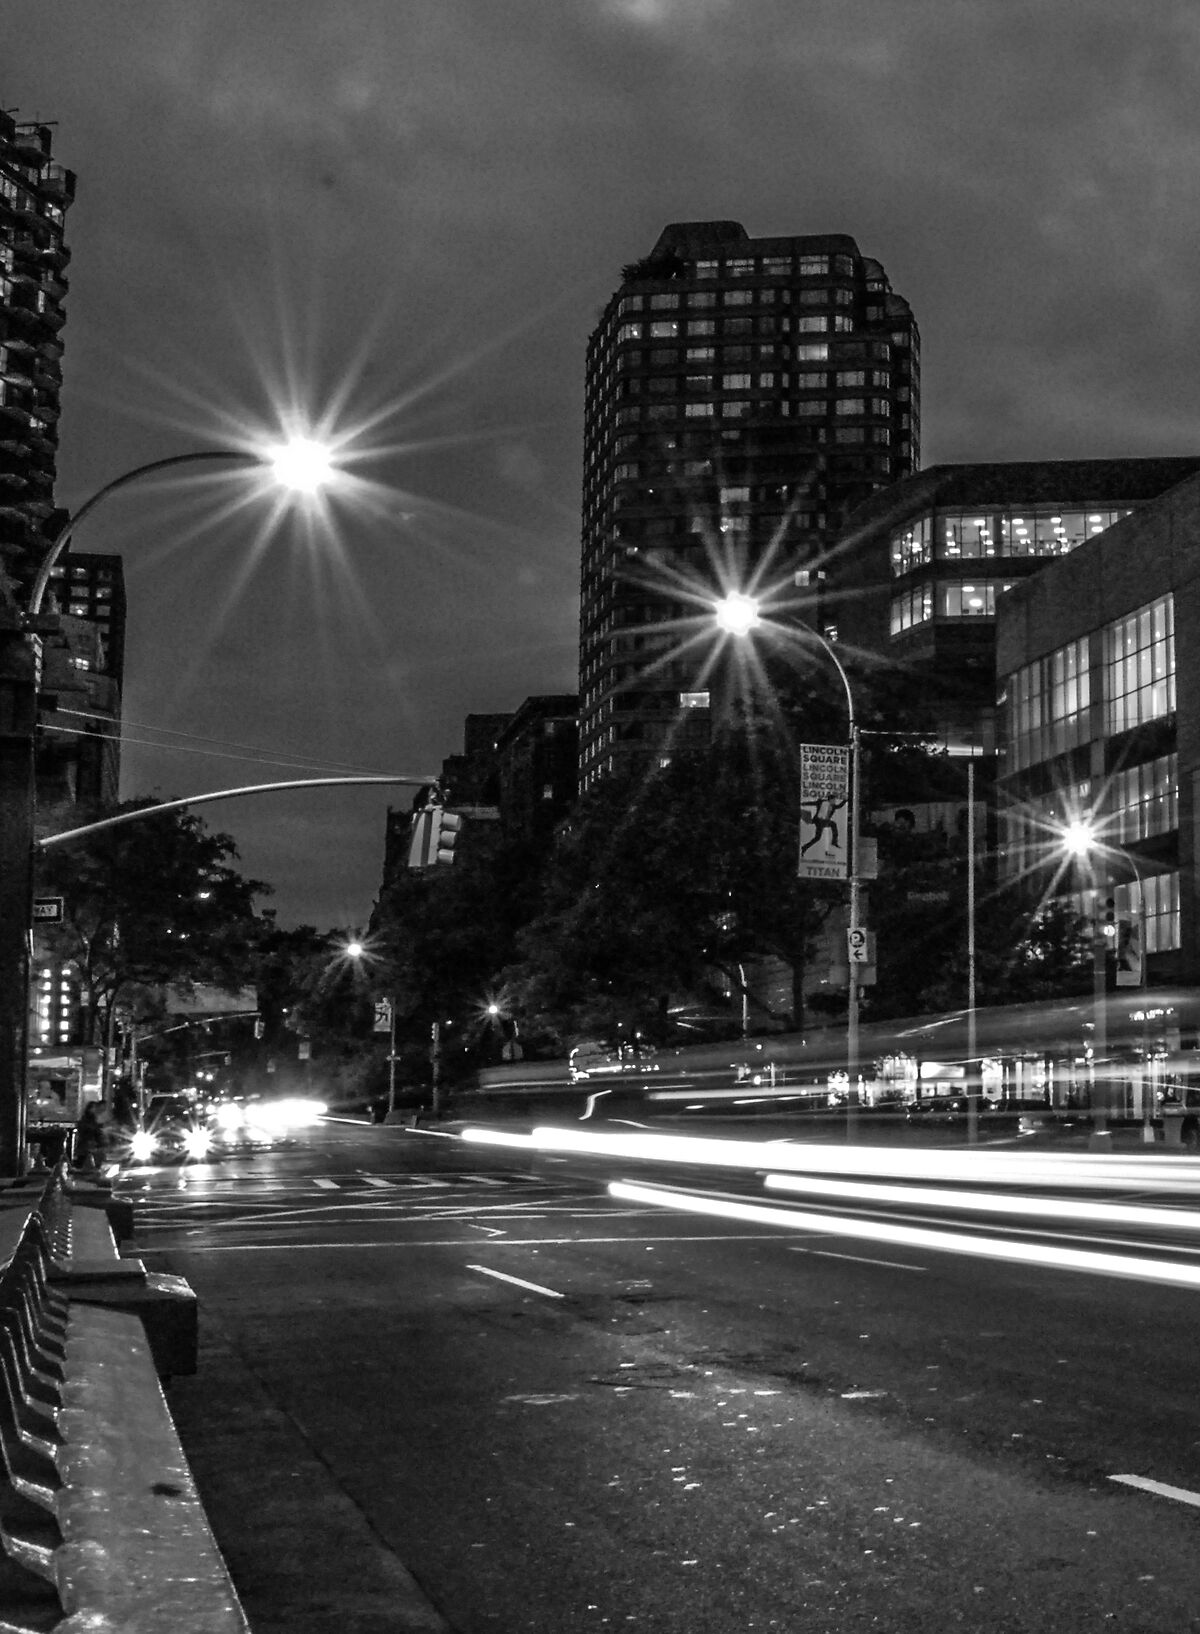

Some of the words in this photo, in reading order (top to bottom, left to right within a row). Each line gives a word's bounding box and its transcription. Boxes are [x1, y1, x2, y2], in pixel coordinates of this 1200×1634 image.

[803, 746, 847, 756] LINCOLN
[803, 754, 847, 765] SQUARE
[803, 764, 847, 773] LINCOLN
[803, 772, 847, 782] SQUARE
[803, 781, 846, 790] LINCOLN
[806, 866, 840, 877] TITAN
